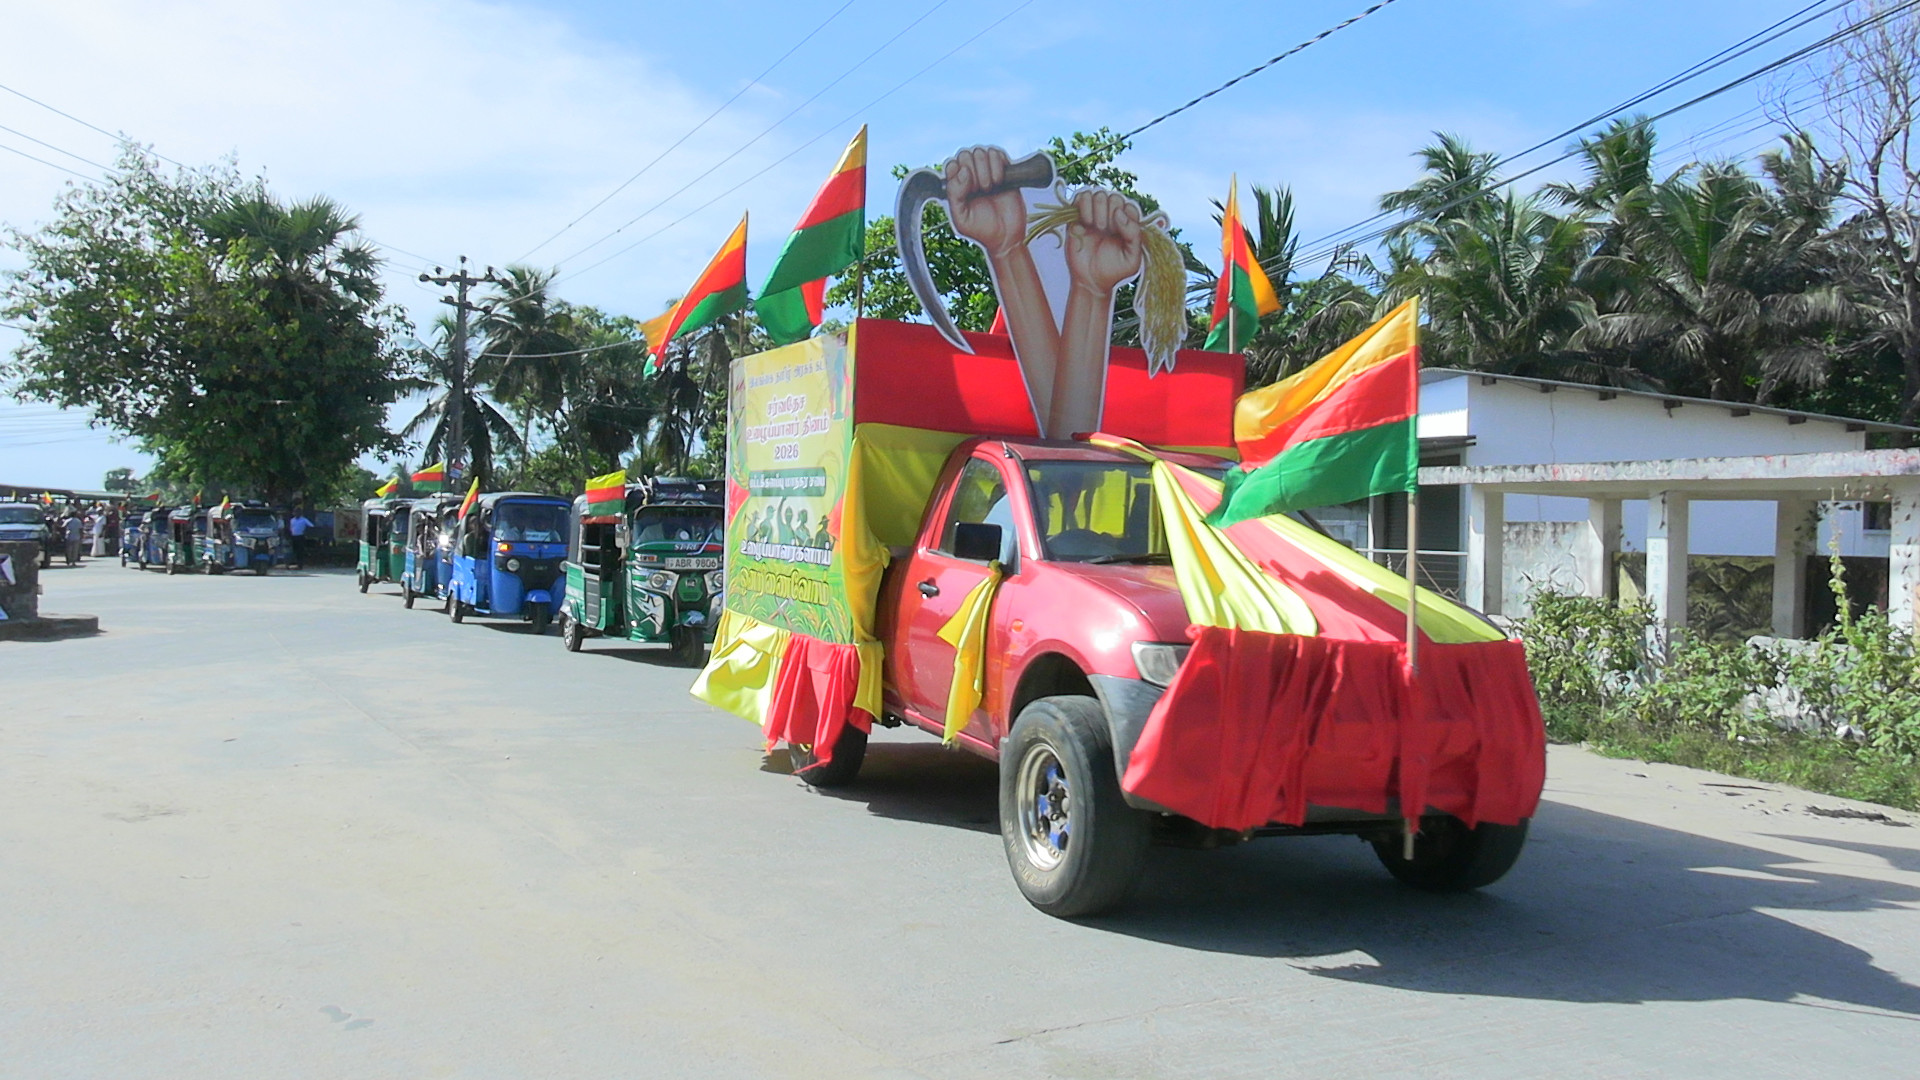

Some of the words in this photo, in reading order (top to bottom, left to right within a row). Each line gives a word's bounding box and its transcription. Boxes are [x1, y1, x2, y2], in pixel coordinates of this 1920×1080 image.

[767, 395, 806, 417] சர்வதேச
[746, 416, 800, 443] உழைப்பாளர்
[801, 410, 829, 436] தினம்
[774, 443, 799, 460] 2026
[740, 536, 832, 567] உழைப்பாளர்களாய்
[675, 558, 692, 568] ABR
[695, 558, 717, 568] 9806
